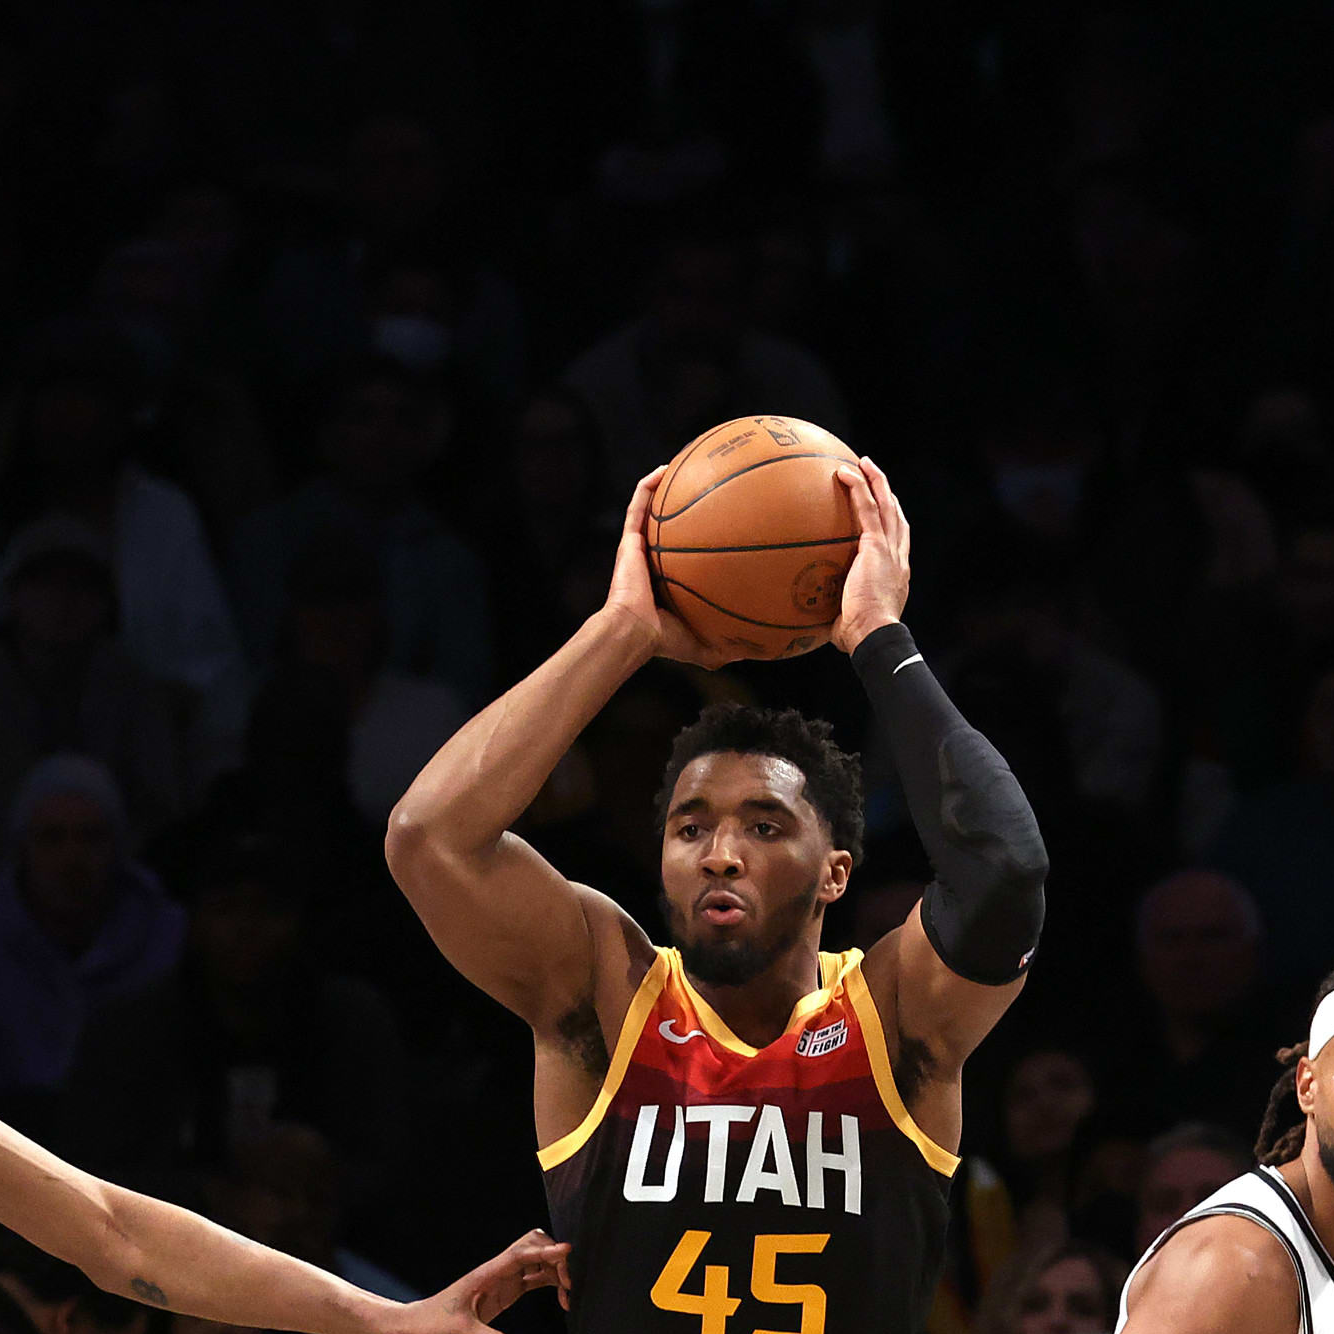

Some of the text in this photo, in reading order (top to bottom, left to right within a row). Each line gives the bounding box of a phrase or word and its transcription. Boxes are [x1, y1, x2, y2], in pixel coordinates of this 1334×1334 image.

[797, 1030, 810, 1053] 5
[812, 1032, 845, 1055] FIGHT
[622, 1103, 861, 1216] UTAH
